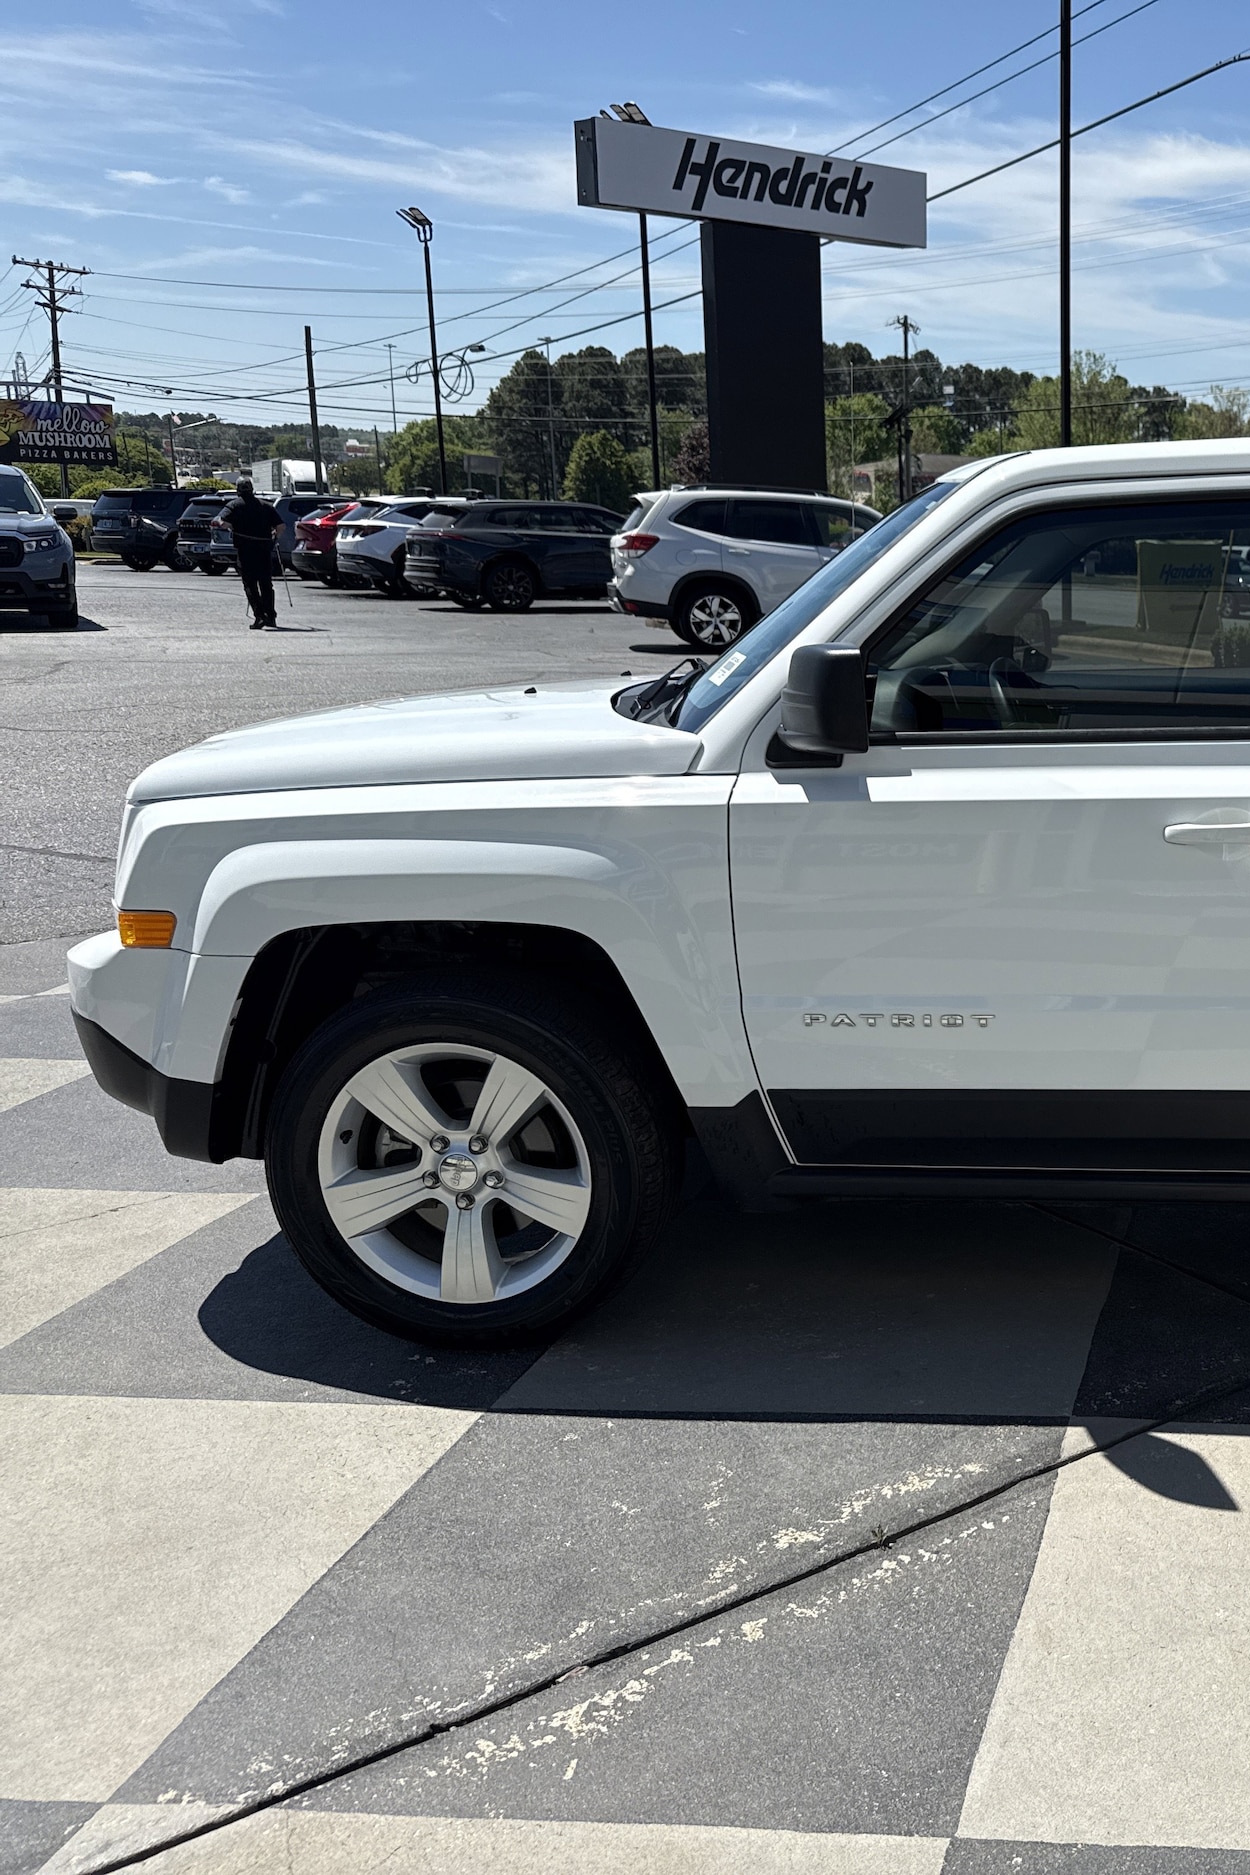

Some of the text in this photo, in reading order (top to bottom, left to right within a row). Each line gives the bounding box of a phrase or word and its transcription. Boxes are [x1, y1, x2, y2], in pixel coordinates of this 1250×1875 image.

[672, 138, 874, 217] Hendrick
[37, 405, 109, 434] mellow
[18, 431, 112, 449] MUSHROOM
[20, 449, 113, 461] PIZZA BAKERS
[1159, 563, 1215, 584] Hendrick
[802, 1013, 996, 1027] PATRIOT
